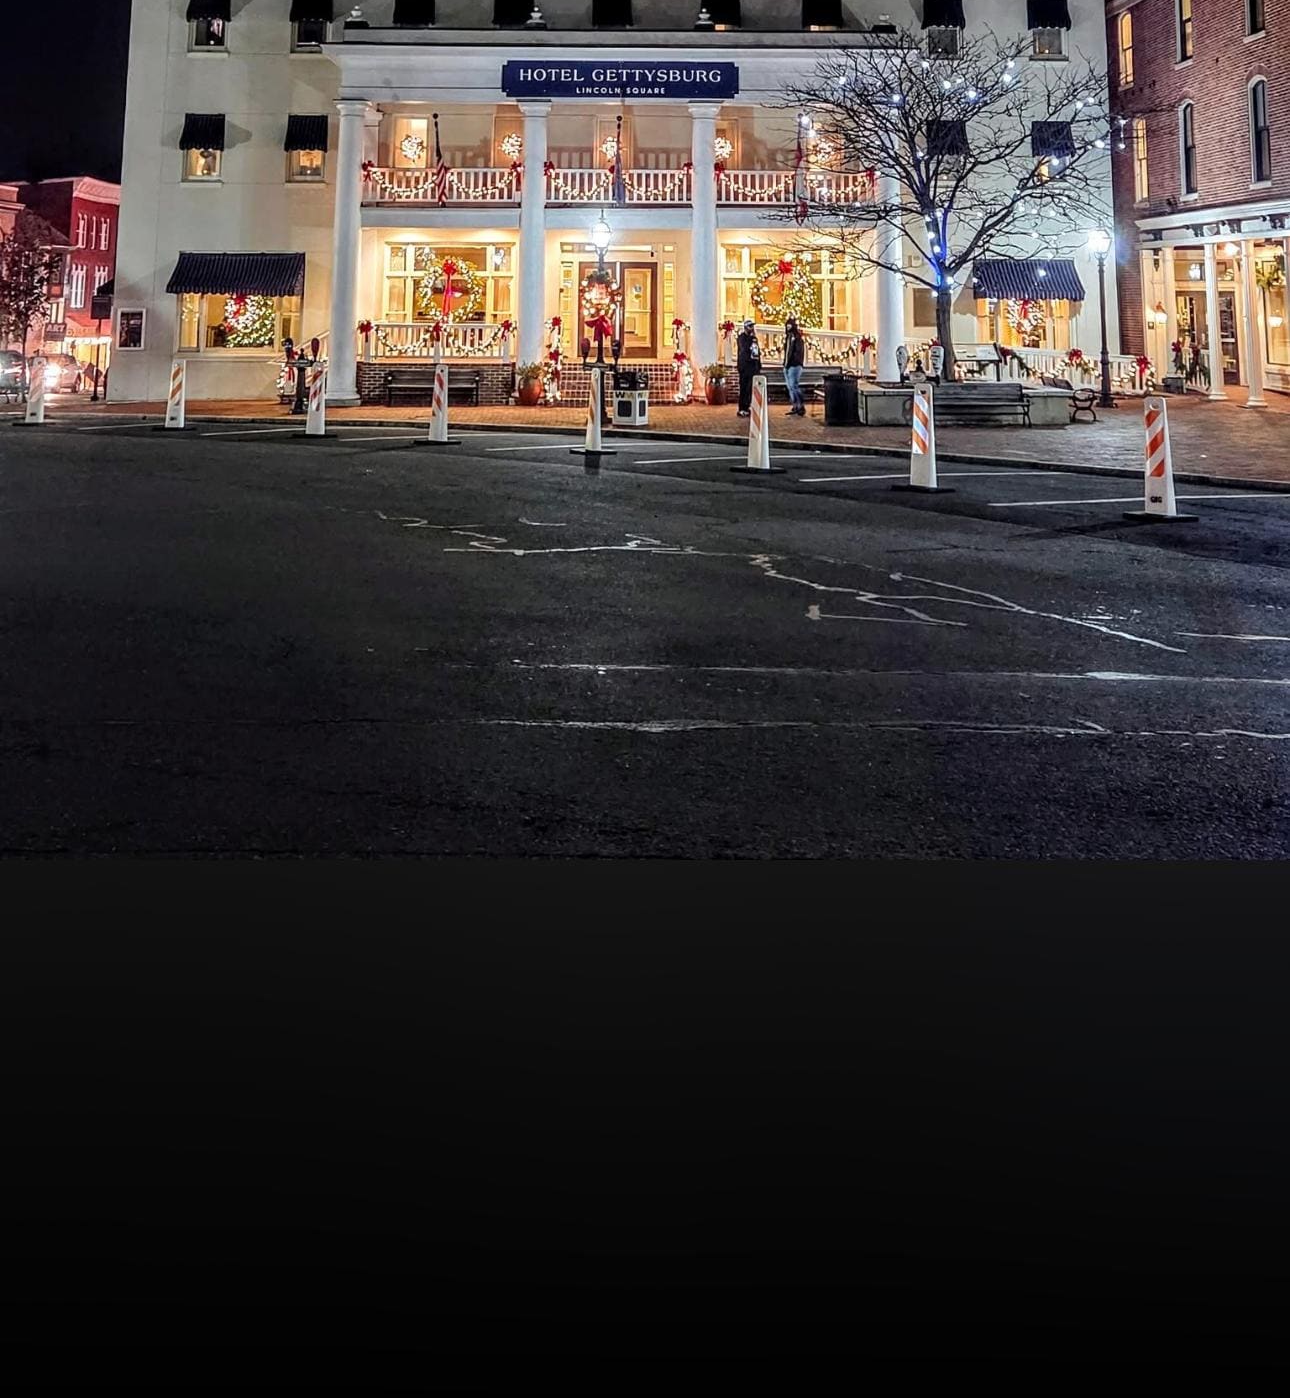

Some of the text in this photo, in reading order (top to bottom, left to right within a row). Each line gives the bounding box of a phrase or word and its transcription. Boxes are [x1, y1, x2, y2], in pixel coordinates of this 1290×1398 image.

[519, 68, 721, 83] HOTEL GETTYSBURG
[576, 86, 665, 95] LINCOLN SQUARE
